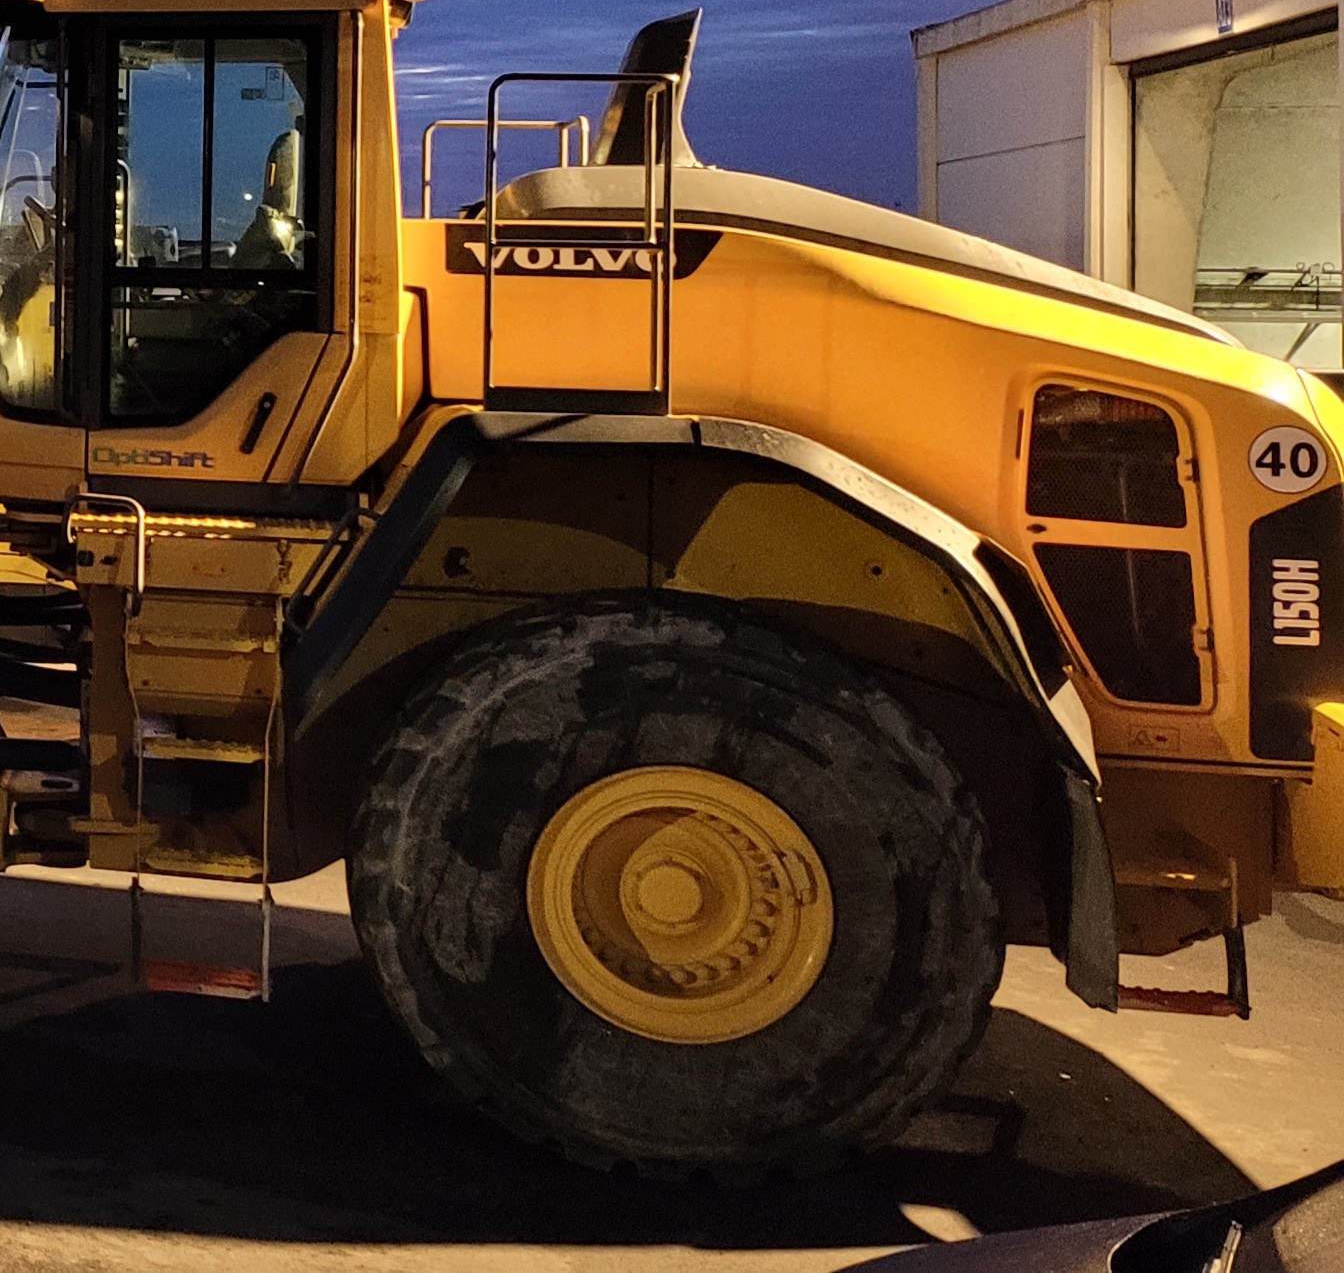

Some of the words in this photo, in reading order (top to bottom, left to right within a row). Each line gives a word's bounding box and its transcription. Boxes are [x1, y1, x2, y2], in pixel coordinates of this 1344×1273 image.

[464, 242, 677, 272] VOLVO
[92, 446, 214, 468] OptiShift
[1255, 441, 1319, 478] 40
[1272, 558, 1320, 646] L150H
